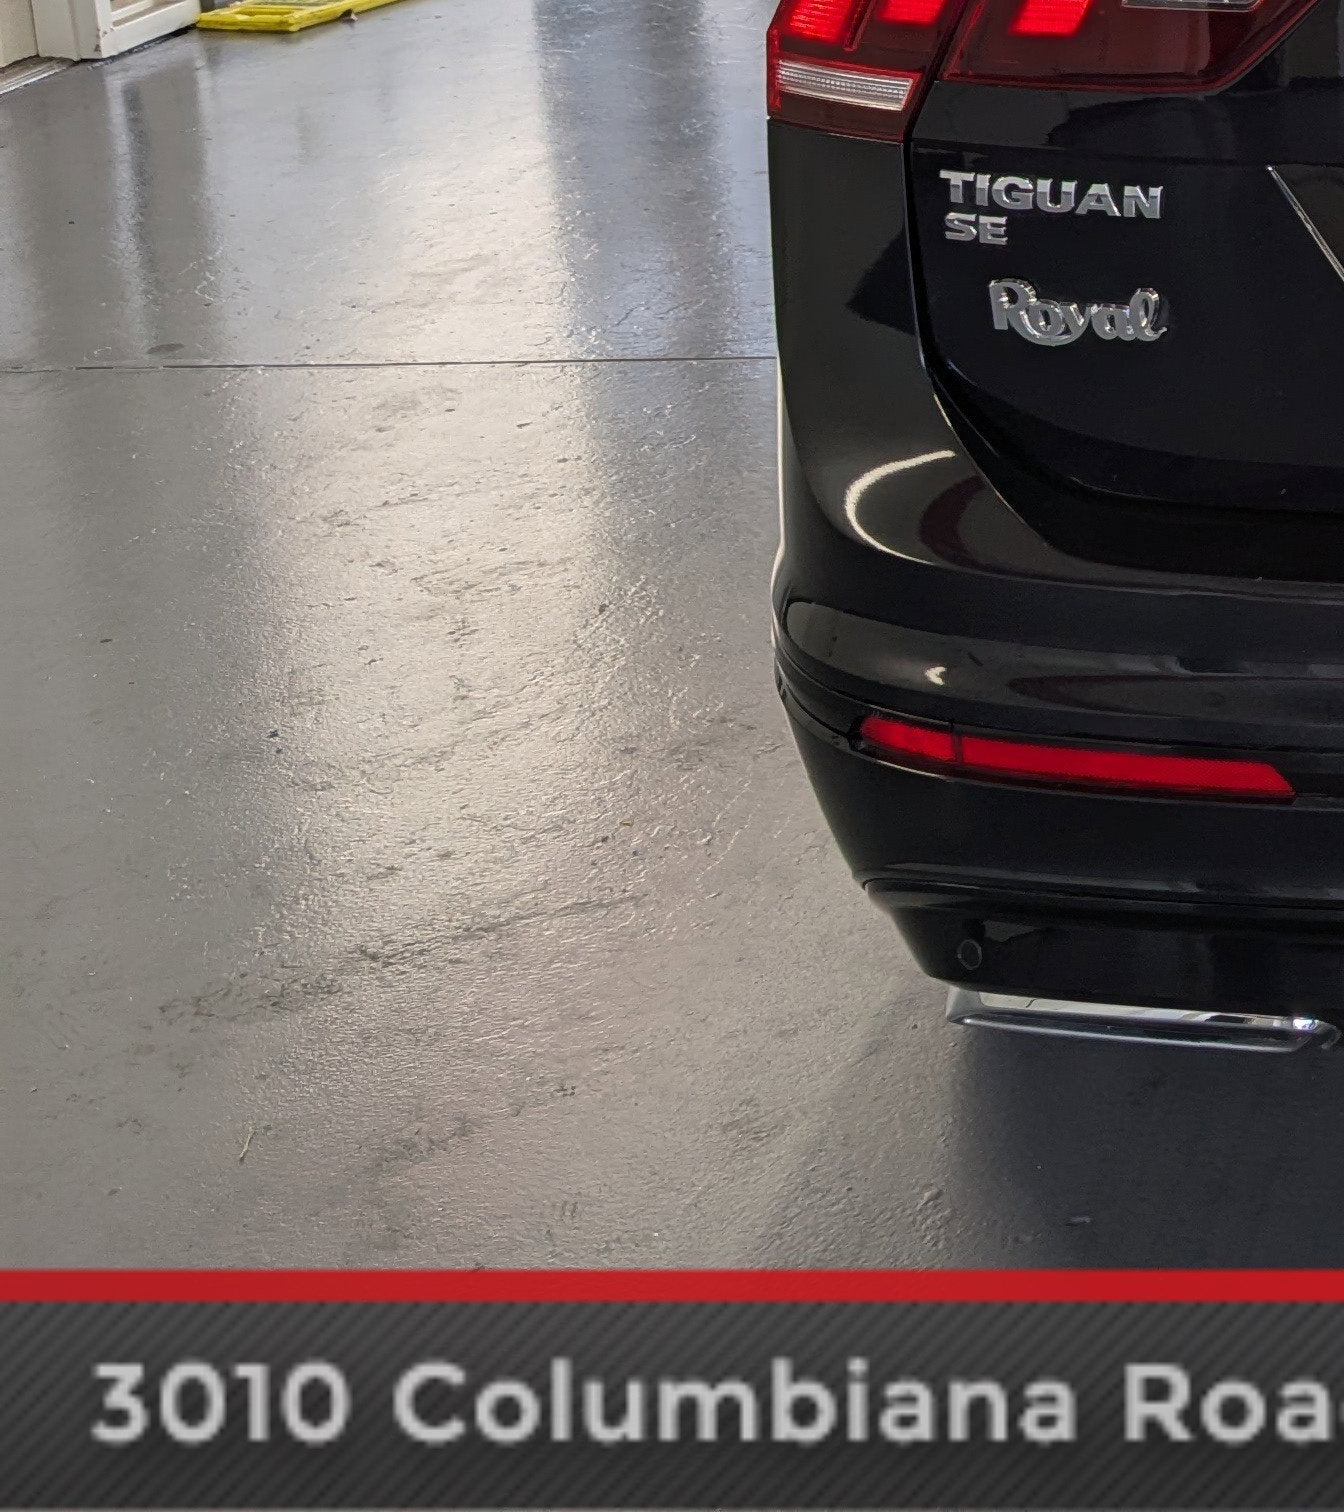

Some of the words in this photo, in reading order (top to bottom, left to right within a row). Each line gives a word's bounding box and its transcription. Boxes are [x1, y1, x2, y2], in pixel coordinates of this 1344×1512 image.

[939, 169, 1164, 219] TIGUAN
[944, 212, 1009, 245] SE
[988, 278, 1168, 346] Royal
